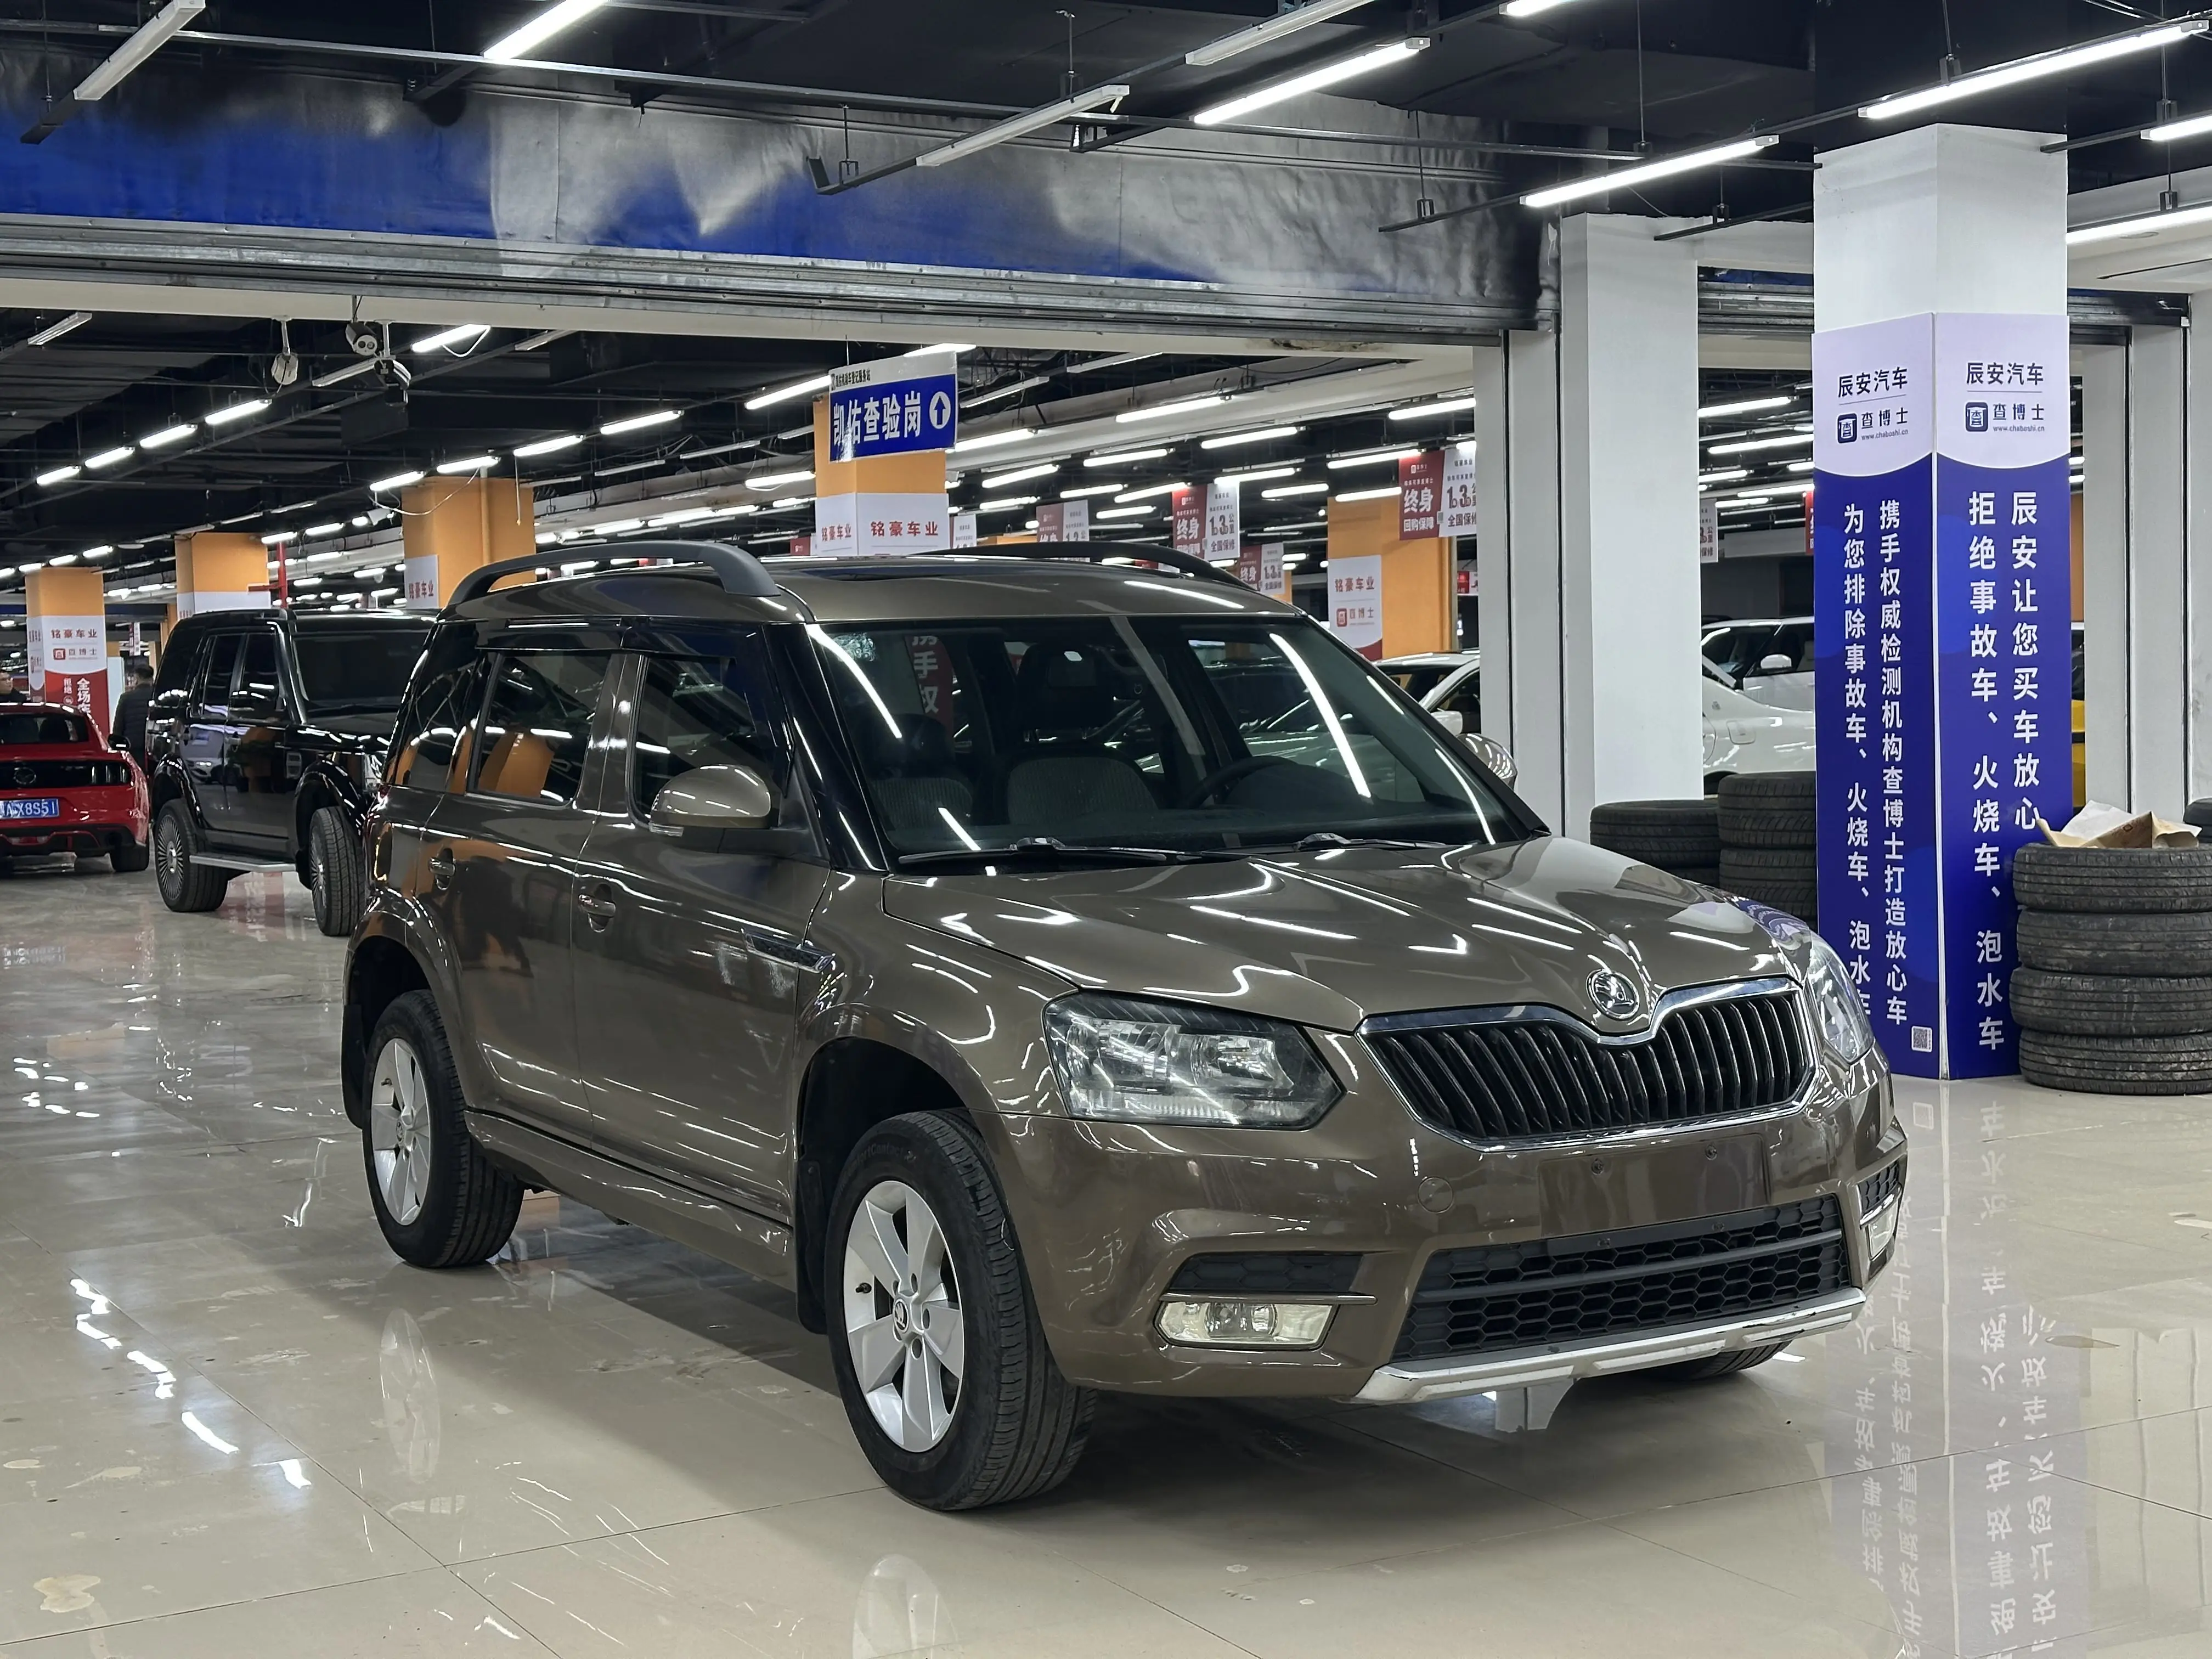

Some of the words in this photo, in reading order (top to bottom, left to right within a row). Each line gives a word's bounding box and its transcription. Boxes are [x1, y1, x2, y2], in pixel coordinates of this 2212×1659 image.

[1838, 366, 1908, 397] 辰安汽车
[1966, 362, 2044, 385] 辰安汽车
[833, 391, 921, 446] 凯佑查验岗
[1861, 407, 1908, 429] 查博士
[1993, 403, 2044, 420] 查博士
[1861, 429, 1909, 441] www.chaboshi.cn
[1404, 487, 1434, 514] 终身
[822, 523, 851, 541] 铭豪车业
[871, 521, 938, 537] 铭豪车业
[1177, 517, 1199, 540] 终身
[1240, 566, 1256, 582] 终身
[1334, 576, 1374, 592] 铭豪车业
[409, 579, 433, 599] 铭豪车业
[51, 629, 97, 639] 铭豪车业
[2011, 492, 2040, 830] 辰安让您买车放心
[1880, 499, 1907, 1025] 携手权威检测机构查博士打造放心车
[1968, 492, 2004, 1050] 拒绝事故车、火烧车、泡水车
